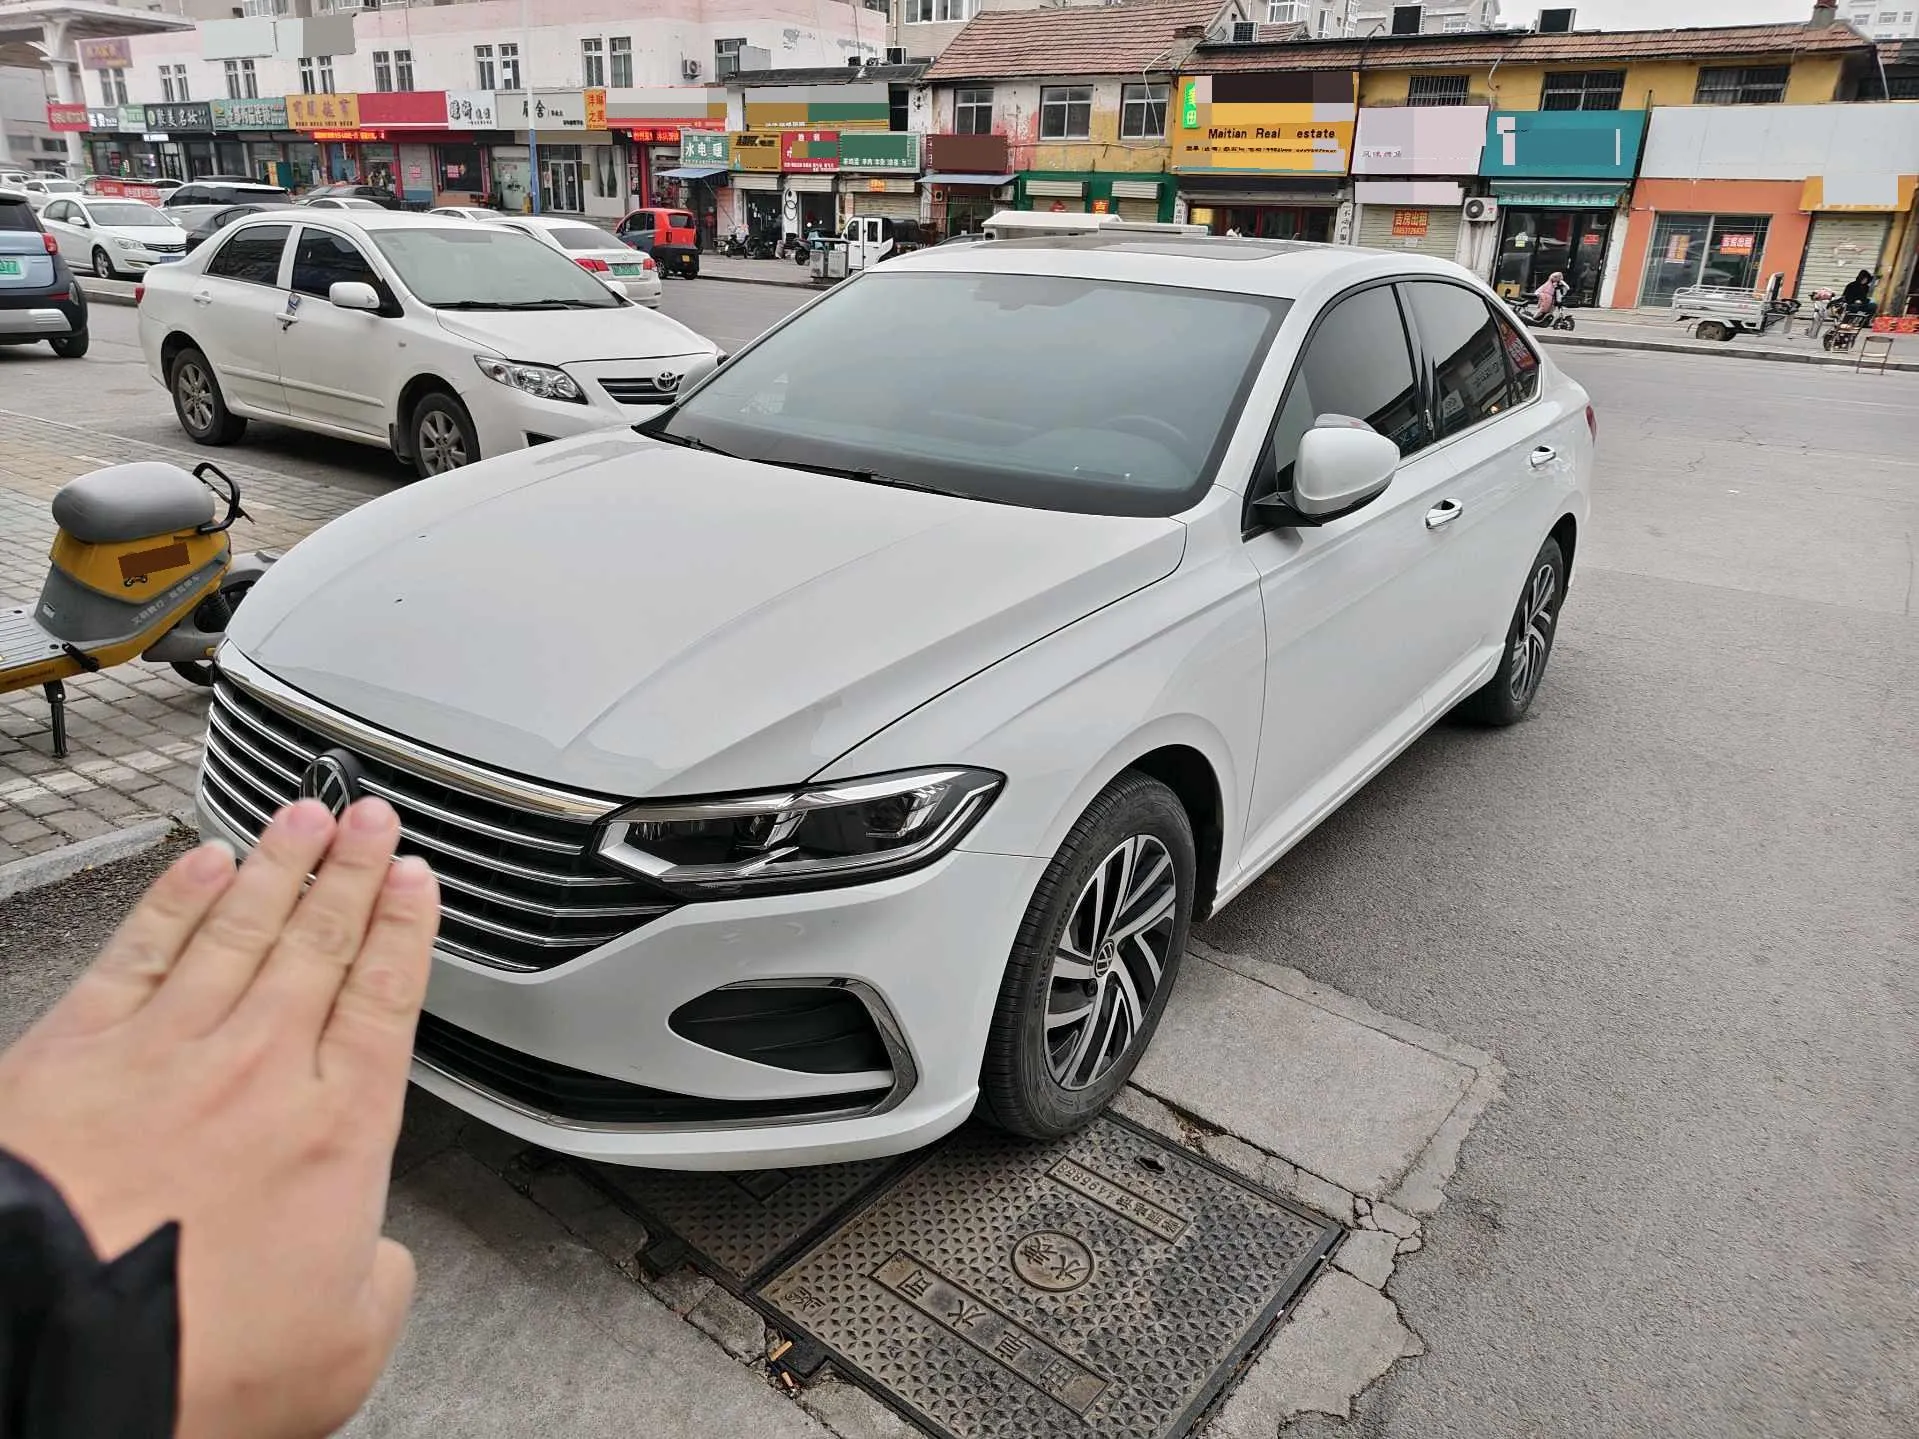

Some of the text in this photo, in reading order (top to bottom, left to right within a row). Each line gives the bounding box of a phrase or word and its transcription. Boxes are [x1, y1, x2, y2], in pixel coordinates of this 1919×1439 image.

[1208, 128, 1335, 139] Maitian Real estate
[1019, 1236, 1088, 1281] 水表
